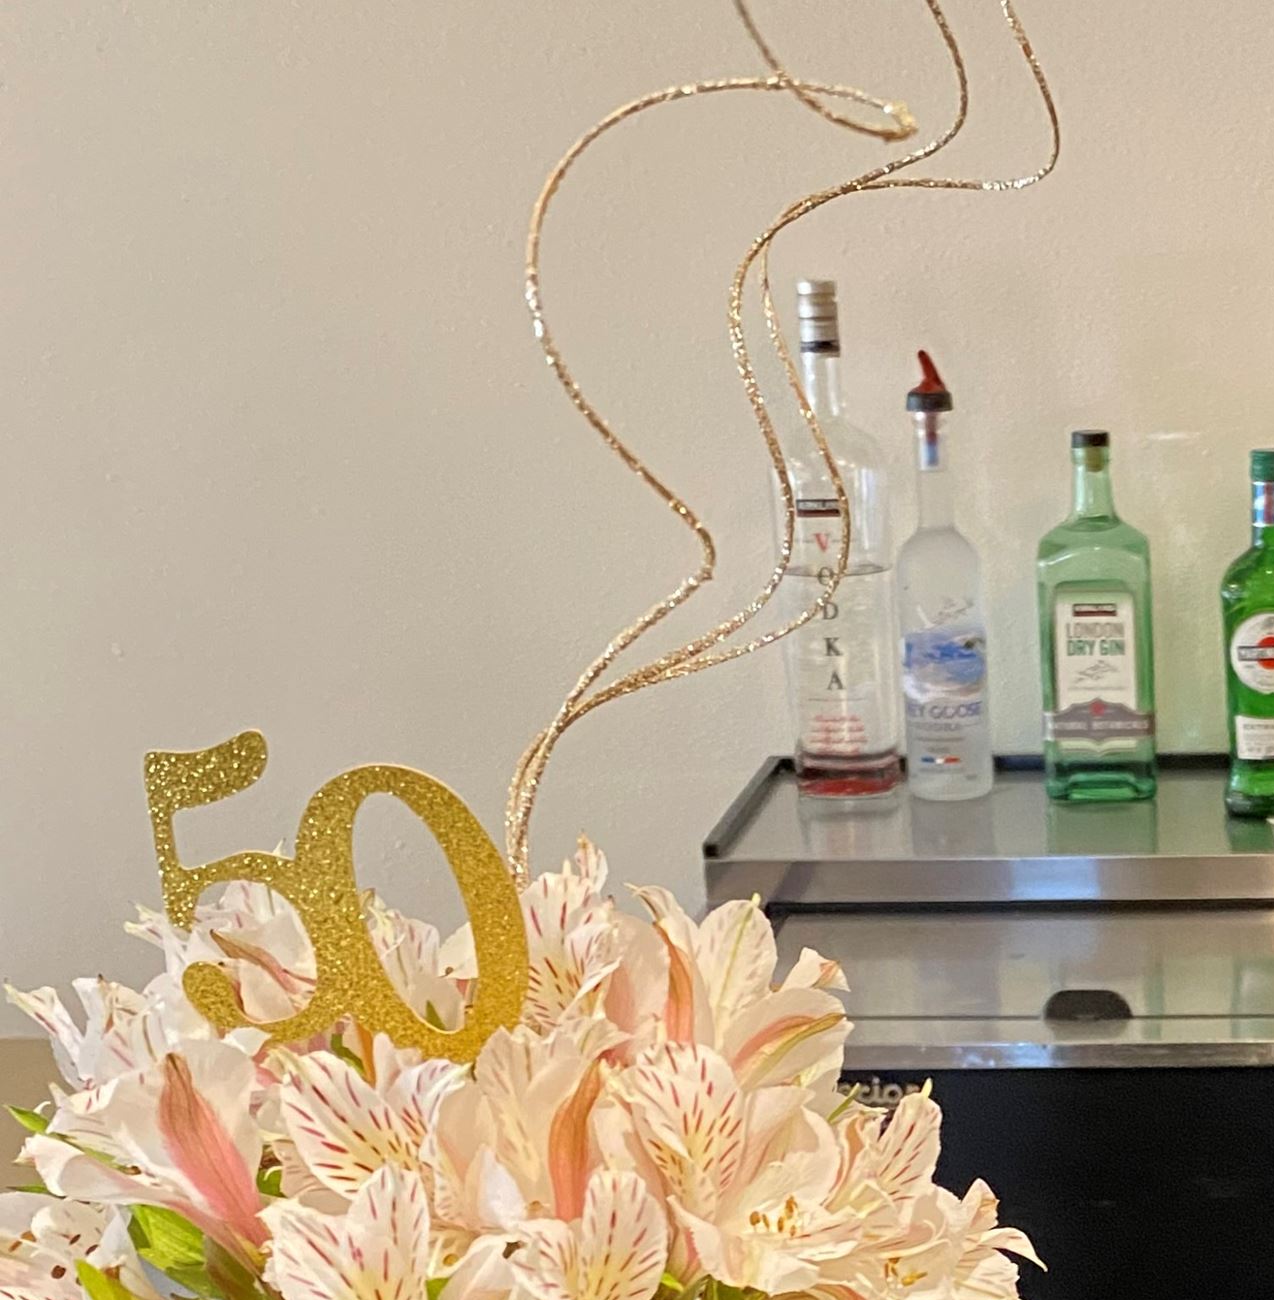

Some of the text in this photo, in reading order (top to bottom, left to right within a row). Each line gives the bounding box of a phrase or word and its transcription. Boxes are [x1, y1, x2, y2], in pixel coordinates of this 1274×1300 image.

[814, 532, 845, 691] VODKA
[1065, 622, 1125, 639] LONDON
[1066, 639, 1126, 657] DRY GIN
[144, 728, 530, 1064] 50
